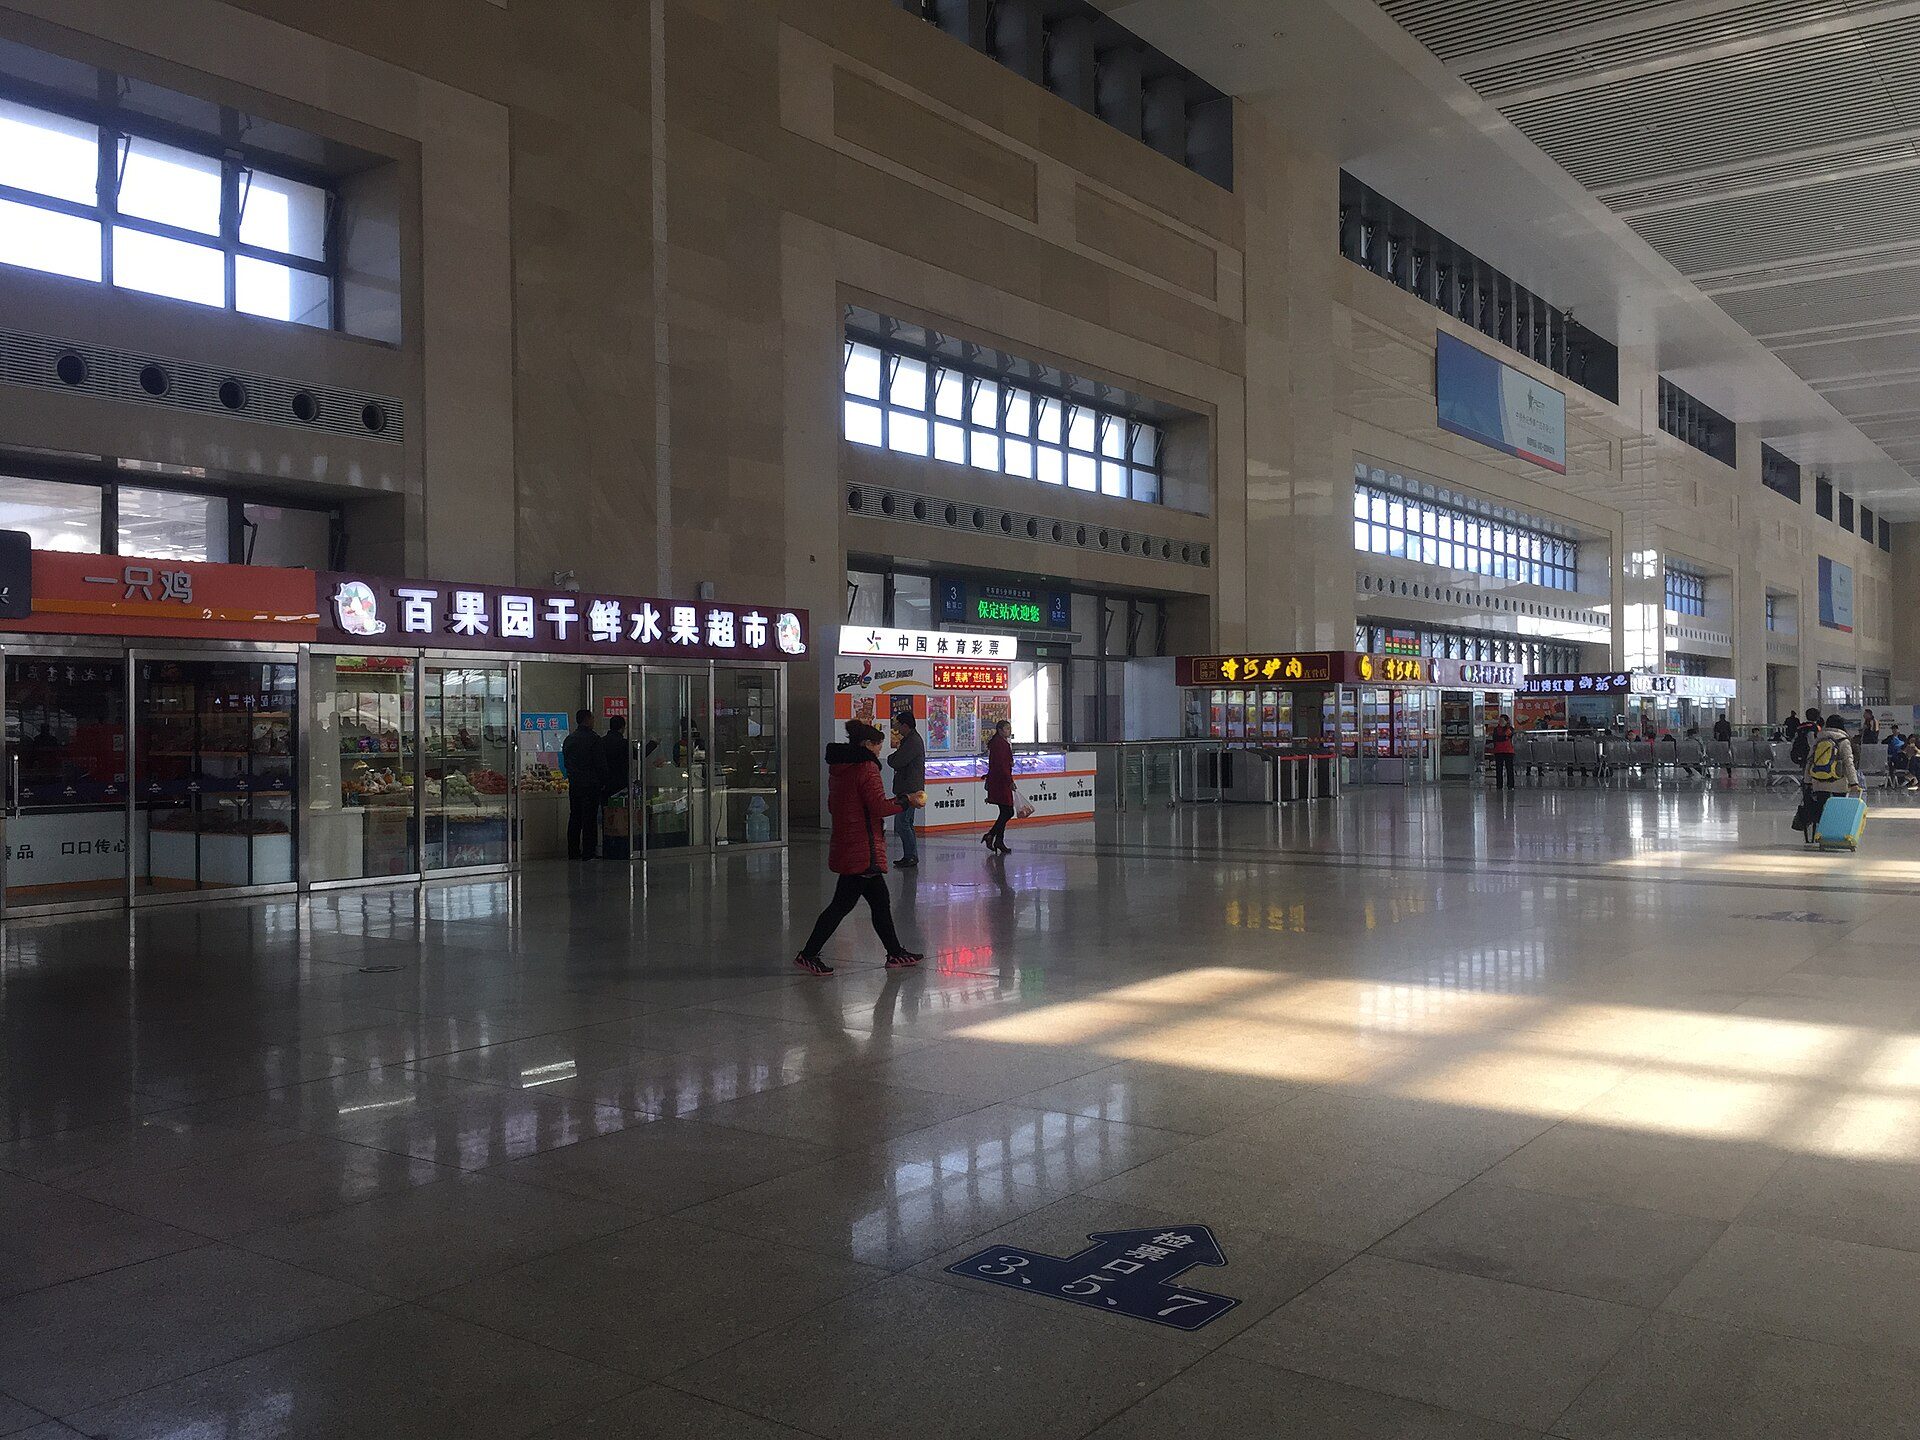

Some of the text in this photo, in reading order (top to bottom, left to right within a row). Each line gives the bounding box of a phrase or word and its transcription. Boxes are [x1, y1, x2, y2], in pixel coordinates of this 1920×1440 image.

[84, 565, 193, 604] 一只鸡
[950, 586, 958, 600] 3
[978, 600, 1040, 623] 保定站欢迎您
[1055, 597, 1062, 610] 3
[397, 588, 769, 649] 百果园干鲜水果超市
[898, 634, 1000, 655] 中国体育彩票
[1101, 1231, 1196, 1275] 检票口
